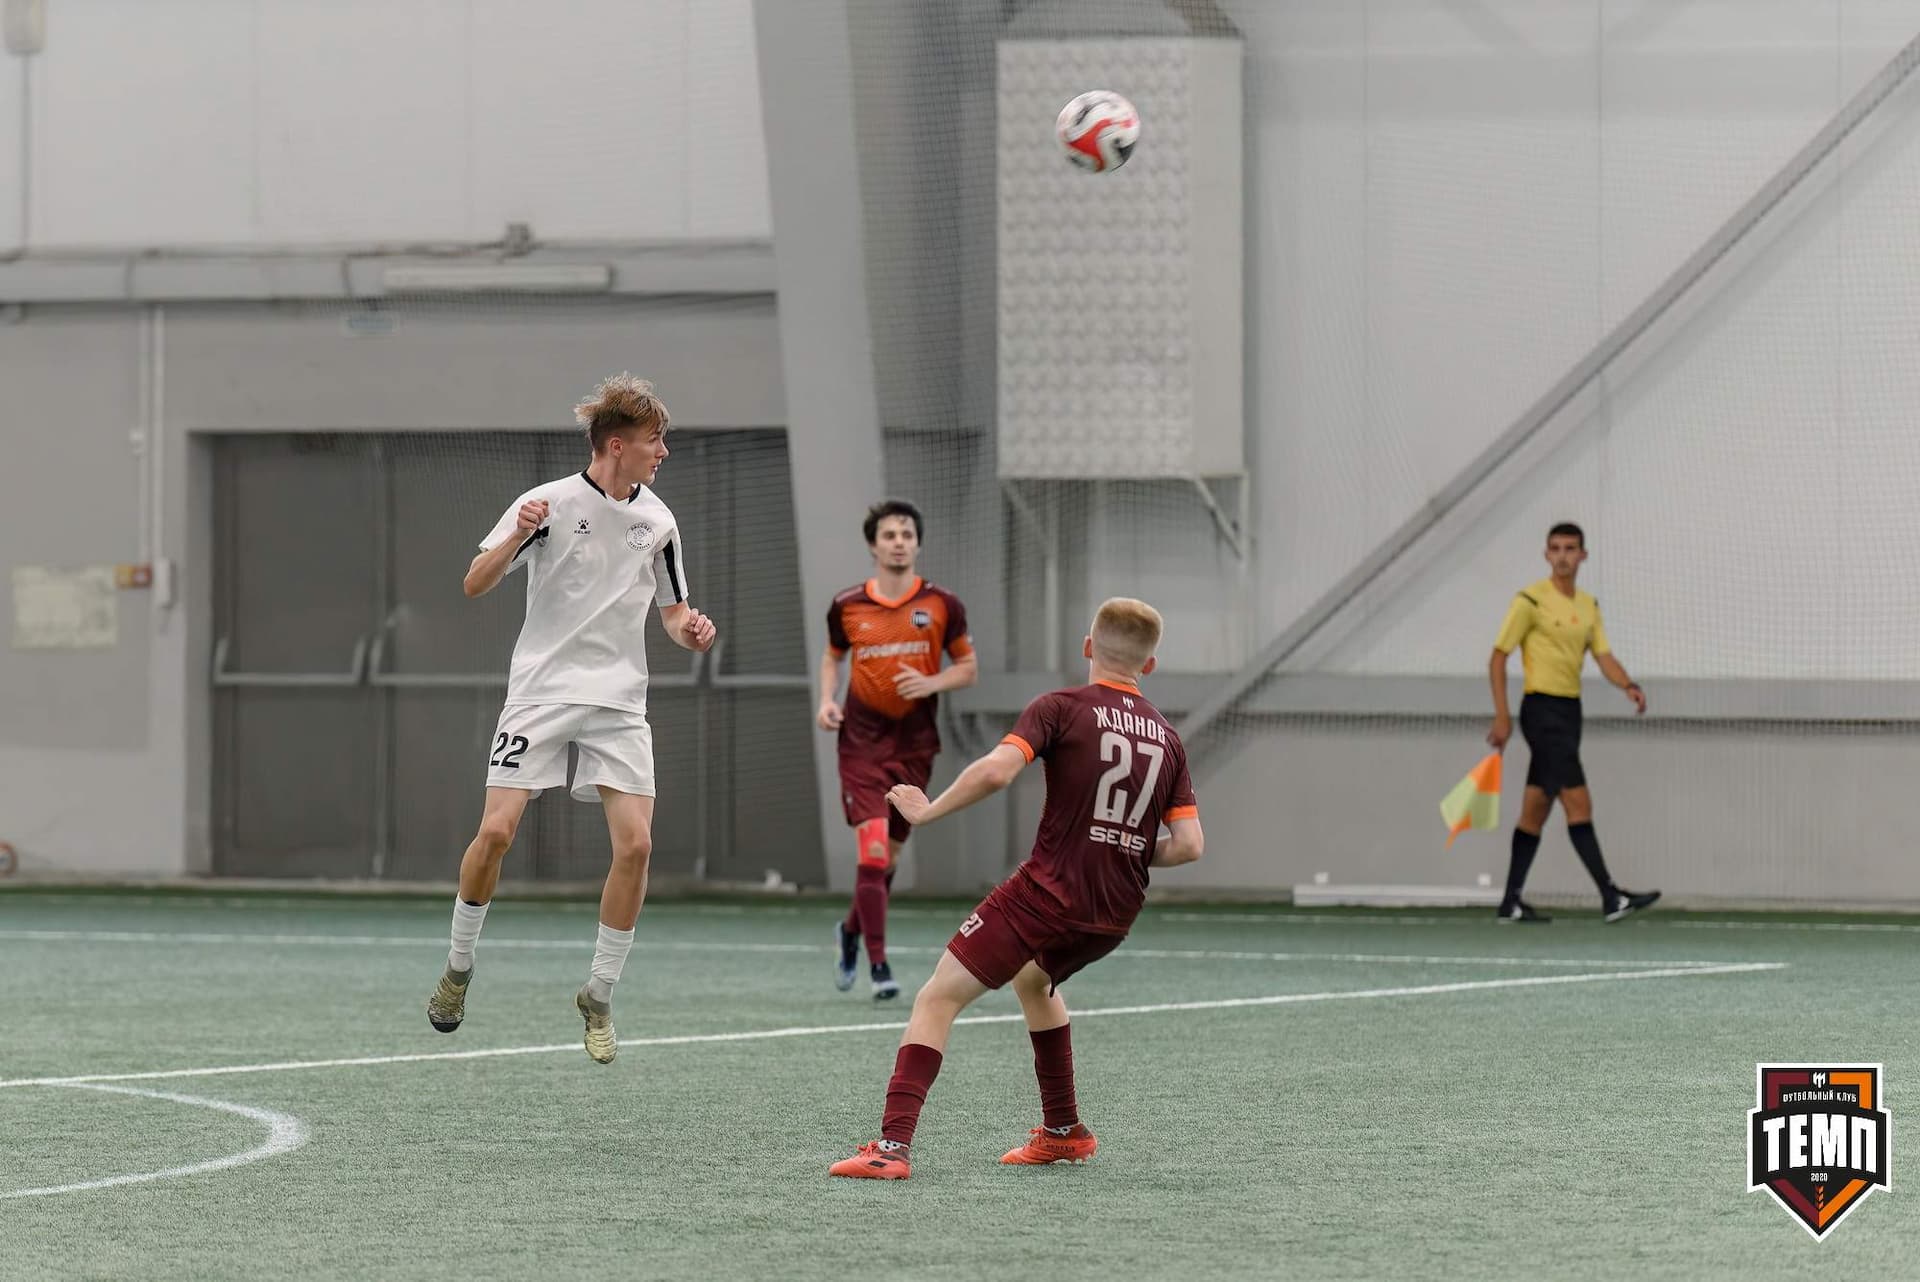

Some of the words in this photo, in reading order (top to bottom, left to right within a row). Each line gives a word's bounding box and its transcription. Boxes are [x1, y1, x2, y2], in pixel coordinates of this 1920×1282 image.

[1092, 705, 1166, 745] ЖДАНОВ
[490, 731, 529, 768] 22
[1093, 731, 1164, 829] 27
[959, 912, 984, 938] 27
